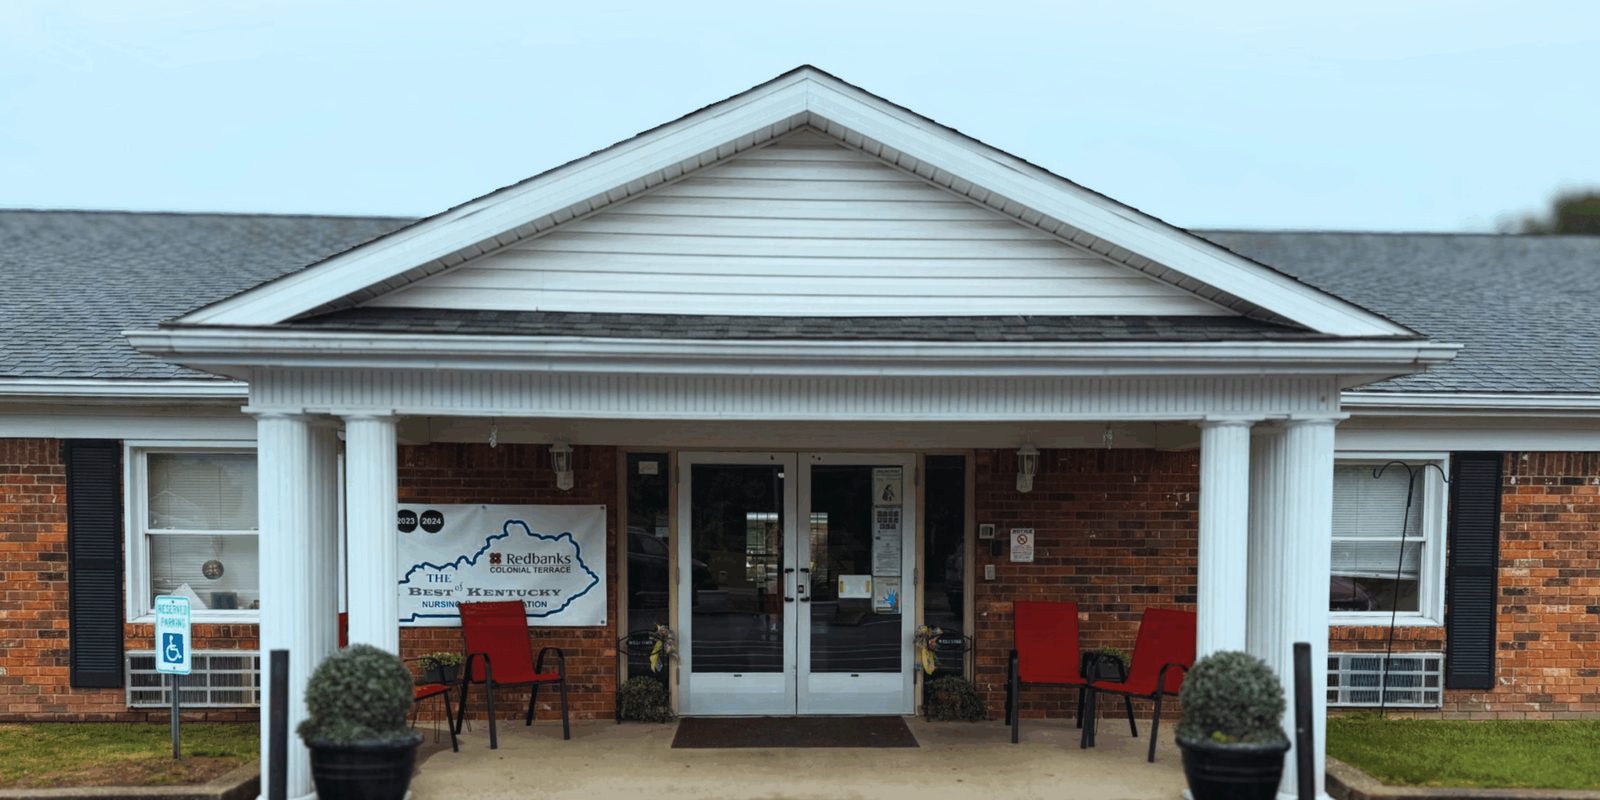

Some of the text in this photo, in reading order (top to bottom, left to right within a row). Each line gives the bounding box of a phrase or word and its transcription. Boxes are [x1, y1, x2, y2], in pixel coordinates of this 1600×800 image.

[422, 517, 442, 525] 2024
[506, 553, 571, 565] Redbanks
[490, 566, 571, 574] COLONIAL TERRACE
[426, 574, 452, 583] THE
[408, 582, 562, 597] BEST of KENTUCKY
[158, 604, 187, 615] RESERVED
